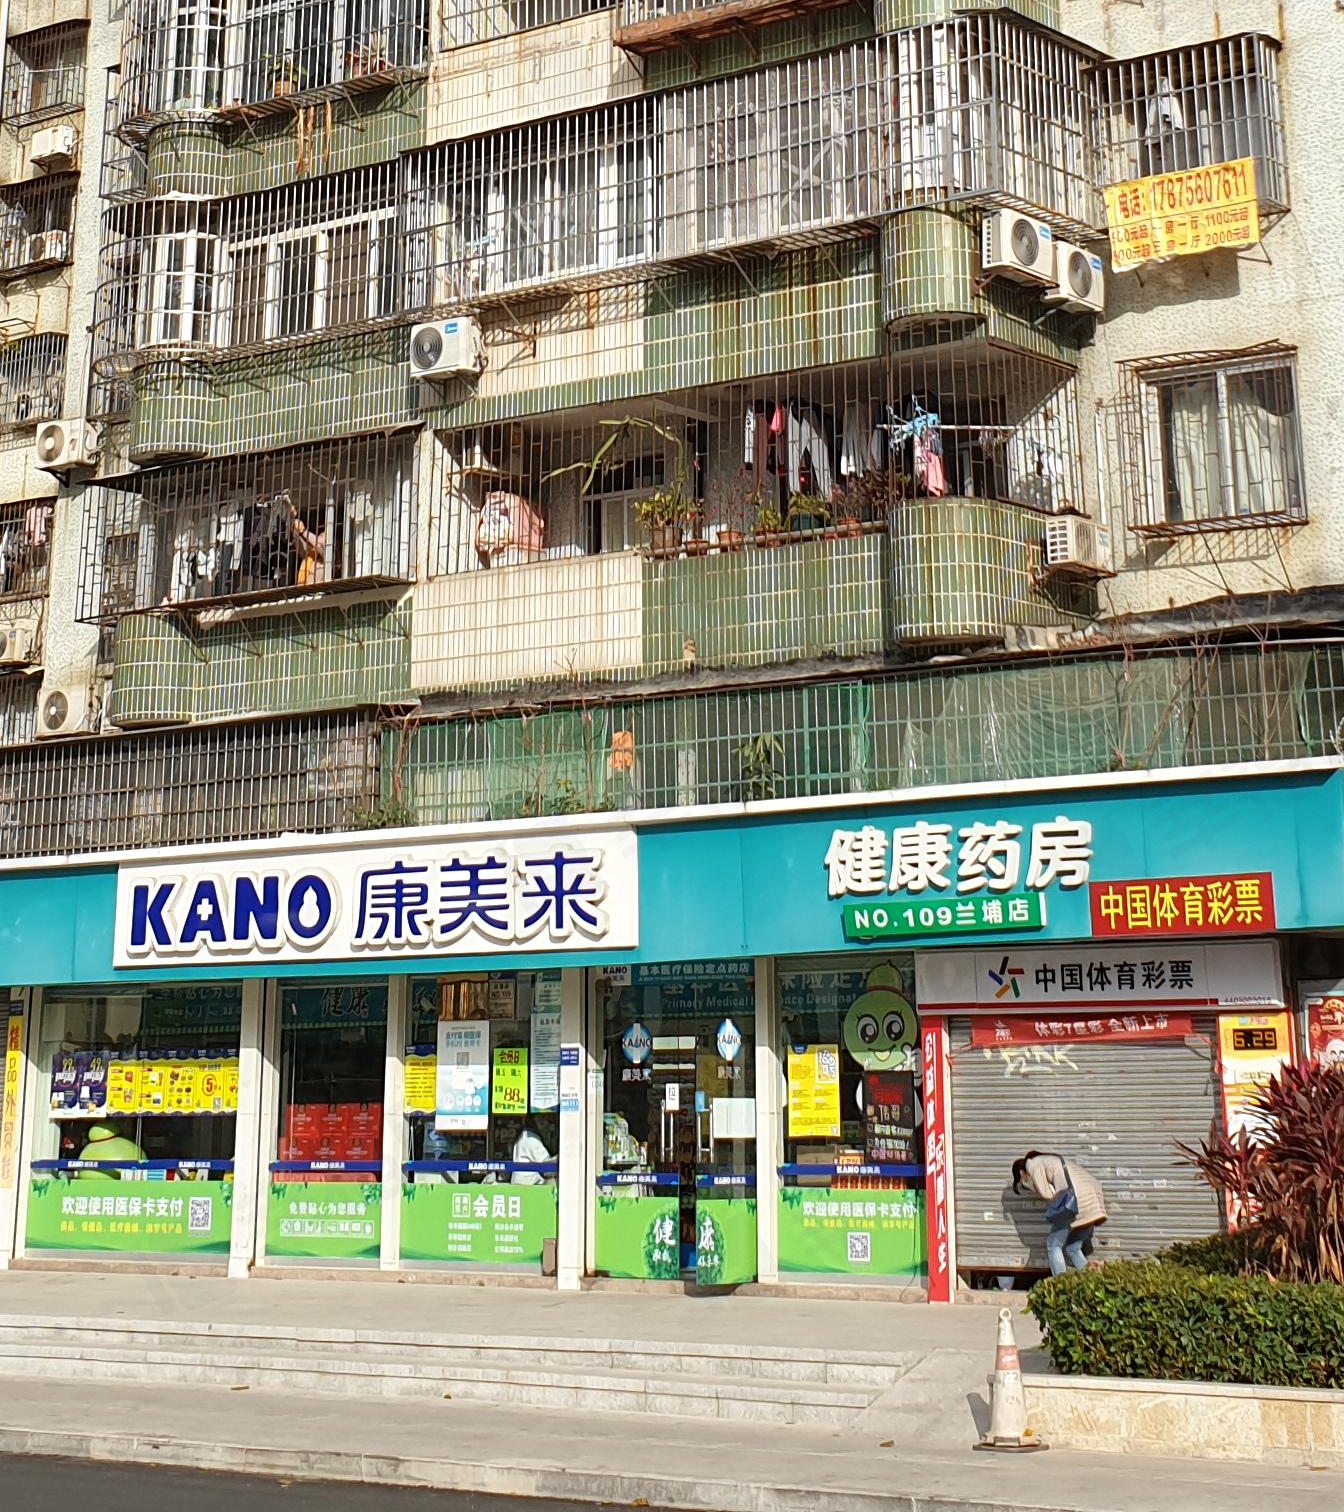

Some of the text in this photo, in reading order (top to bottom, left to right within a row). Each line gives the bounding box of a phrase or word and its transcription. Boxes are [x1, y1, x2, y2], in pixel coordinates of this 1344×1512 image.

[824, 816, 1093, 896] 健康药房
[130, 852, 598, 945] KANO 康美来
[1100, 879, 1263, 930] 中国体育彩票
[602, 967, 627, 975] KANO
[1035, 960, 1194, 993] 中国体育彩票
[62, 1196, 184, 1217] 欢迎使用医保卡支付
[289, 1202, 367, 1216] 免费贴心为您服务
[472, 1194, 521, 1218] 会员日
[802, 1201, 916, 1218] 欢迎使用医保卡支付
